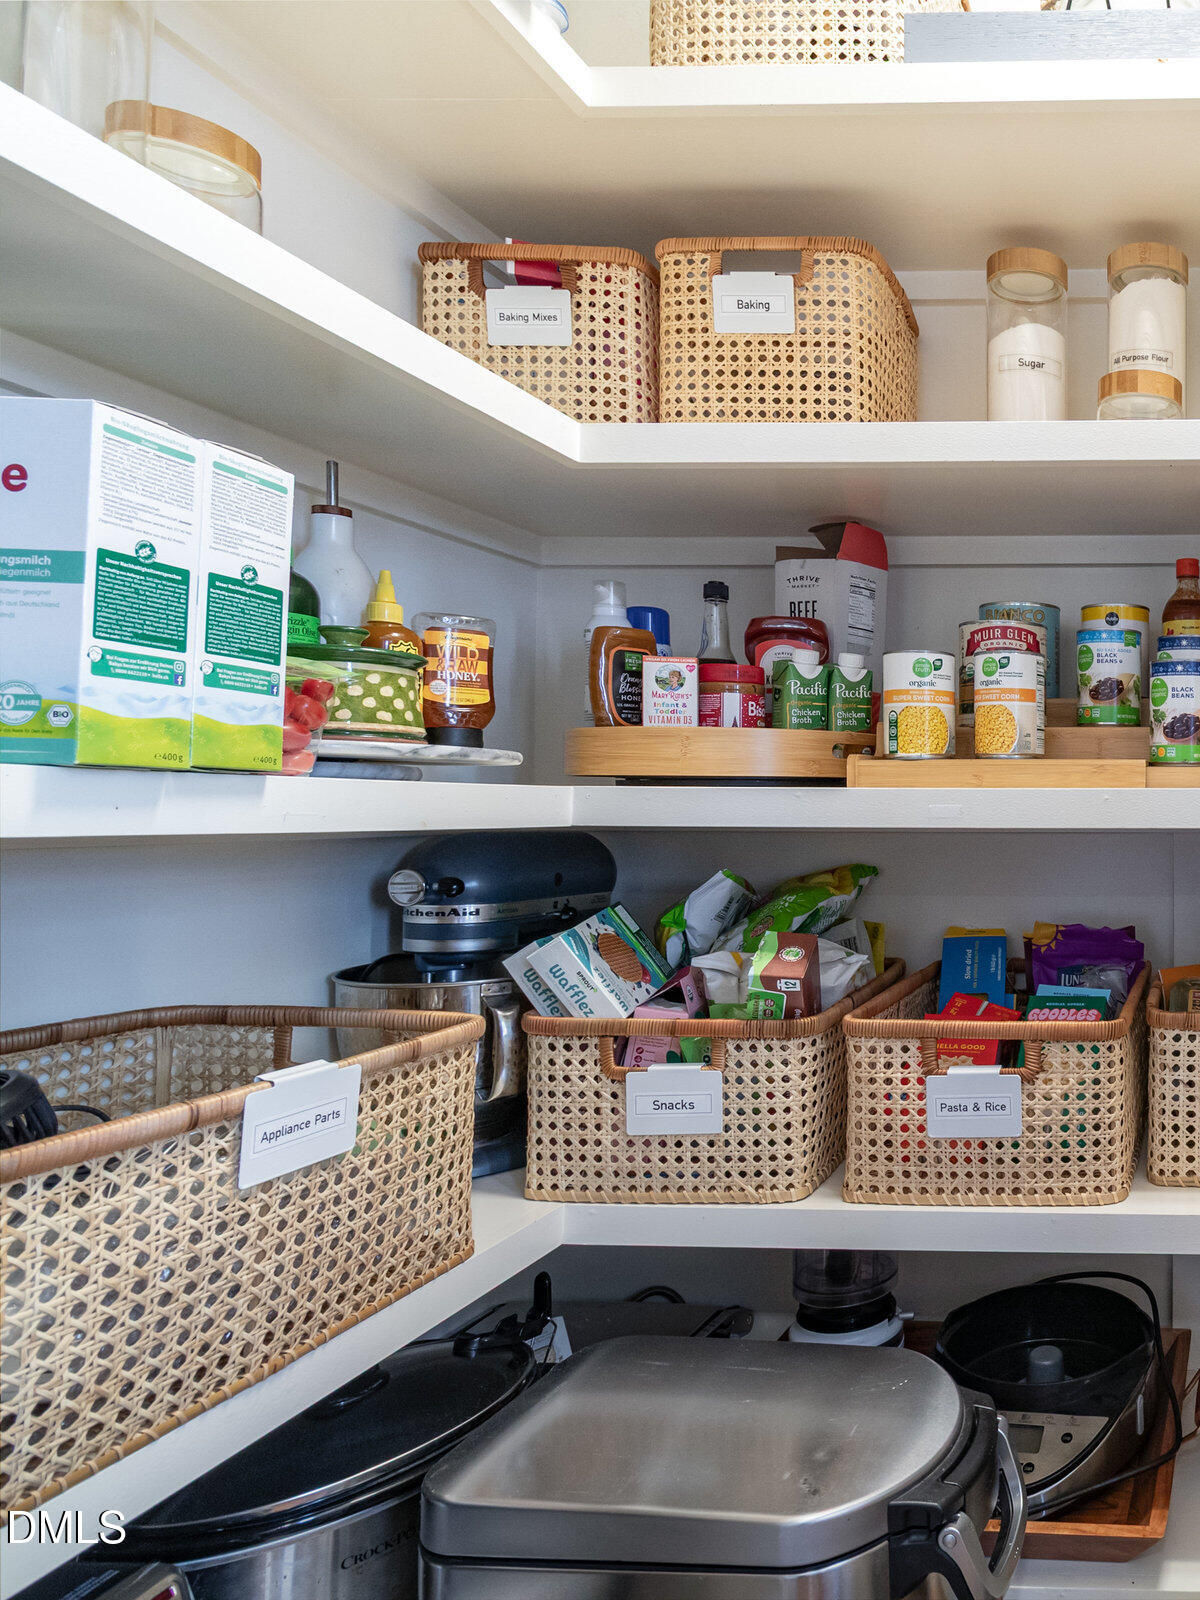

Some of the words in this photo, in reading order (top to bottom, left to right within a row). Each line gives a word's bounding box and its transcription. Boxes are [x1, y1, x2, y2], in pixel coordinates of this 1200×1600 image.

[737, 299, 770, 313] Baking
[498, 312, 530, 326] Baking
[532, 312, 559, 324] Mixes
[1018, 357, 1046, 370] Sugar
[1121, 354, 1149, 364] Purpose
[1151, 353, 1169, 363] Flour
[786, 574, 821, 584] THRIVE
[974, 628, 1001, 643] MUIR
[1006, 628, 1034, 644] GLEN
[436, 644, 479, 661] WILD
[786, 679, 827, 696] Pacific
[908, 679, 937, 687] organic
[979, 678, 1003, 687] organic
[832, 682, 873, 699] Pacific
[893, 694, 912, 702] SUPER
[912, 694, 934, 702] SWEET
[791, 708, 820, 717] Chicken
[836, 711, 866, 719] Chicken
[683, 715, 693, 725] D3
[791, 716, 813, 724] Broth
[836, 718, 858, 726] Broth
[576, 970, 595, 991] SPROUT
[549, 963, 595, 1017] Wafflez
[960, 1043, 986, 1051] GOOD
[652, 1099, 695, 1111] Snacks
[940, 1101, 968, 1113] Pasta
[973, 1101, 981, 1113] &
[985, 1101, 1007, 1113] Rice
[260, 1119, 311, 1144] Appliance
[314, 1110, 341, 1125] Parts
